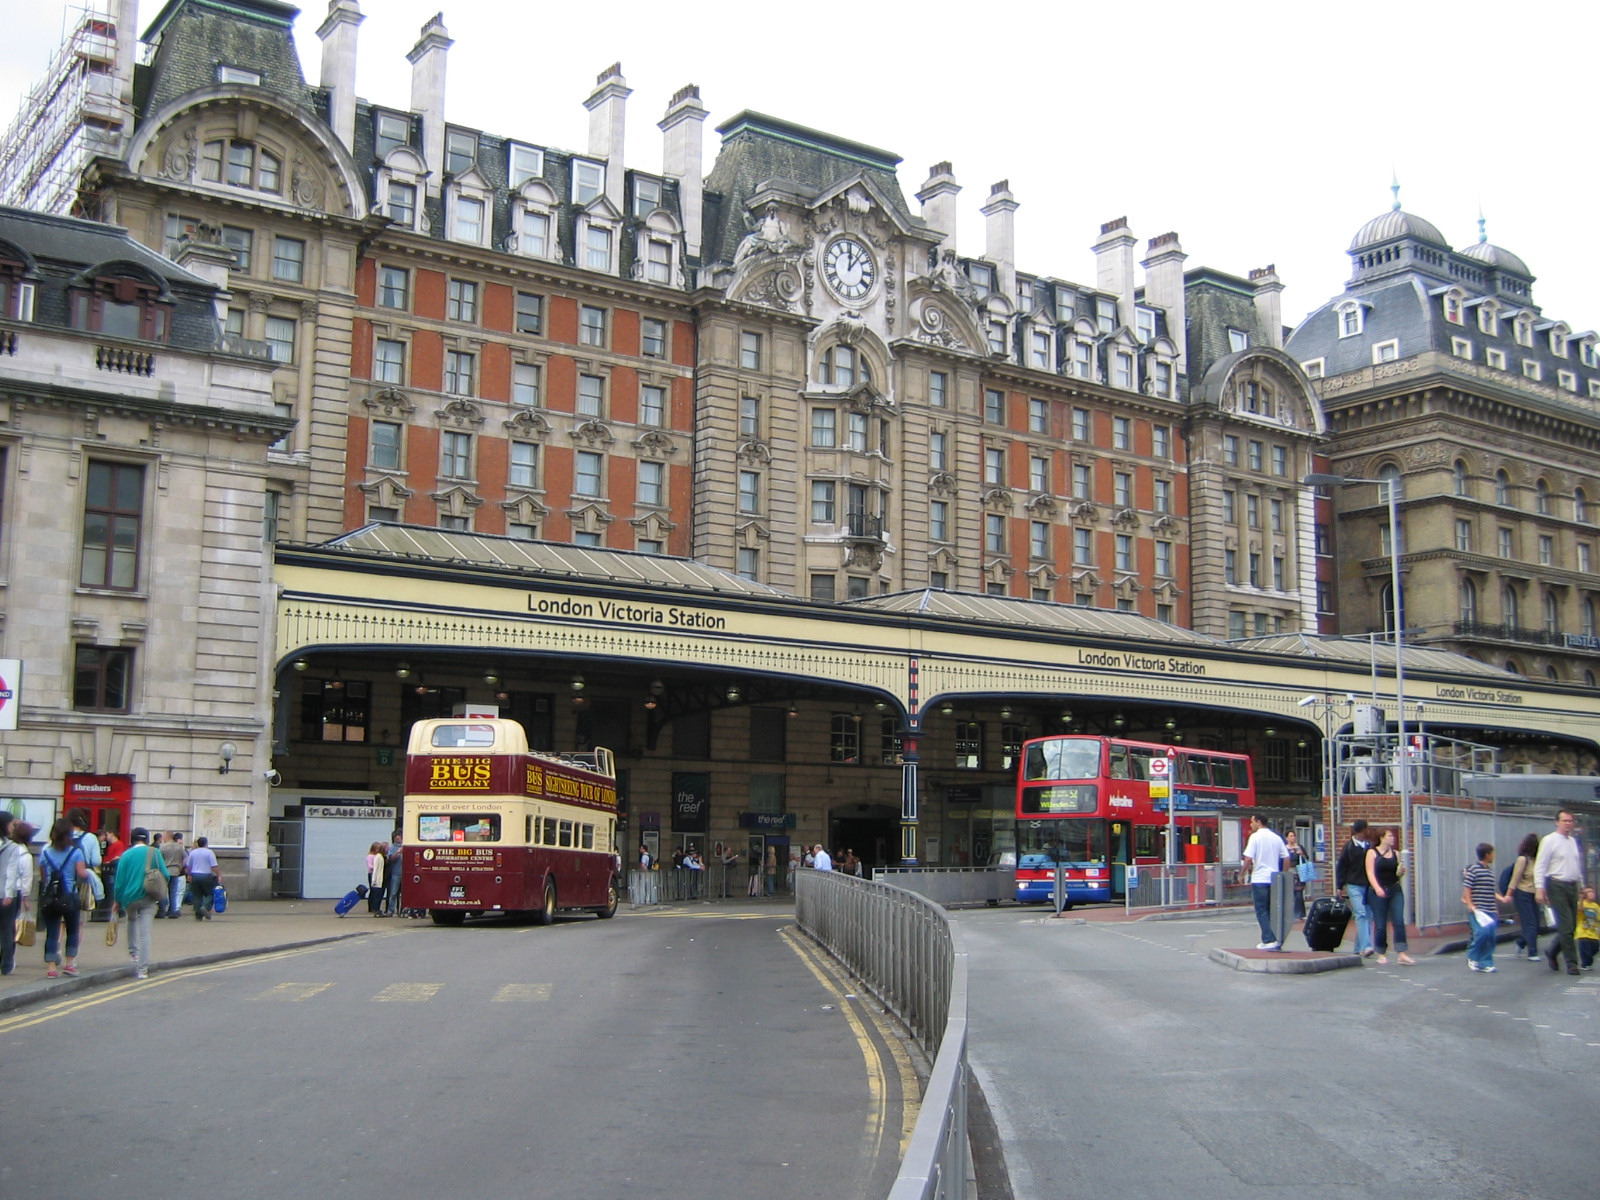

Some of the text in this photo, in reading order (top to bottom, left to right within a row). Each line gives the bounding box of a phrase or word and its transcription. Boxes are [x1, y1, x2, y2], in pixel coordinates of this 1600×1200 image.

[528, 593, 725, 629] London Victoria Station
[1078, 649, 1206, 675] London Victoria Station
[1436, 684, 1522, 703] London Victoria Station
[1167, 747, 1175, 756] A
[431, 757, 491, 765] THE BIG
[430, 764, 491, 780] BUS
[526, 769, 543, 786] BUS
[74, 783, 112, 792] threshers
[545, 774, 580, 797] SIGHTSEEING
[580, 782, 594, 800] TOUR
[594, 786, 601, 802] OF
[678, 791, 694, 803] the
[1109, 794, 1133, 807] Metroline
[321, 807, 356, 817] CLASS
[679, 800, 701, 813] reef
[758, 815, 770, 824] the
[436, 848, 494, 856] THE BIG BUS
